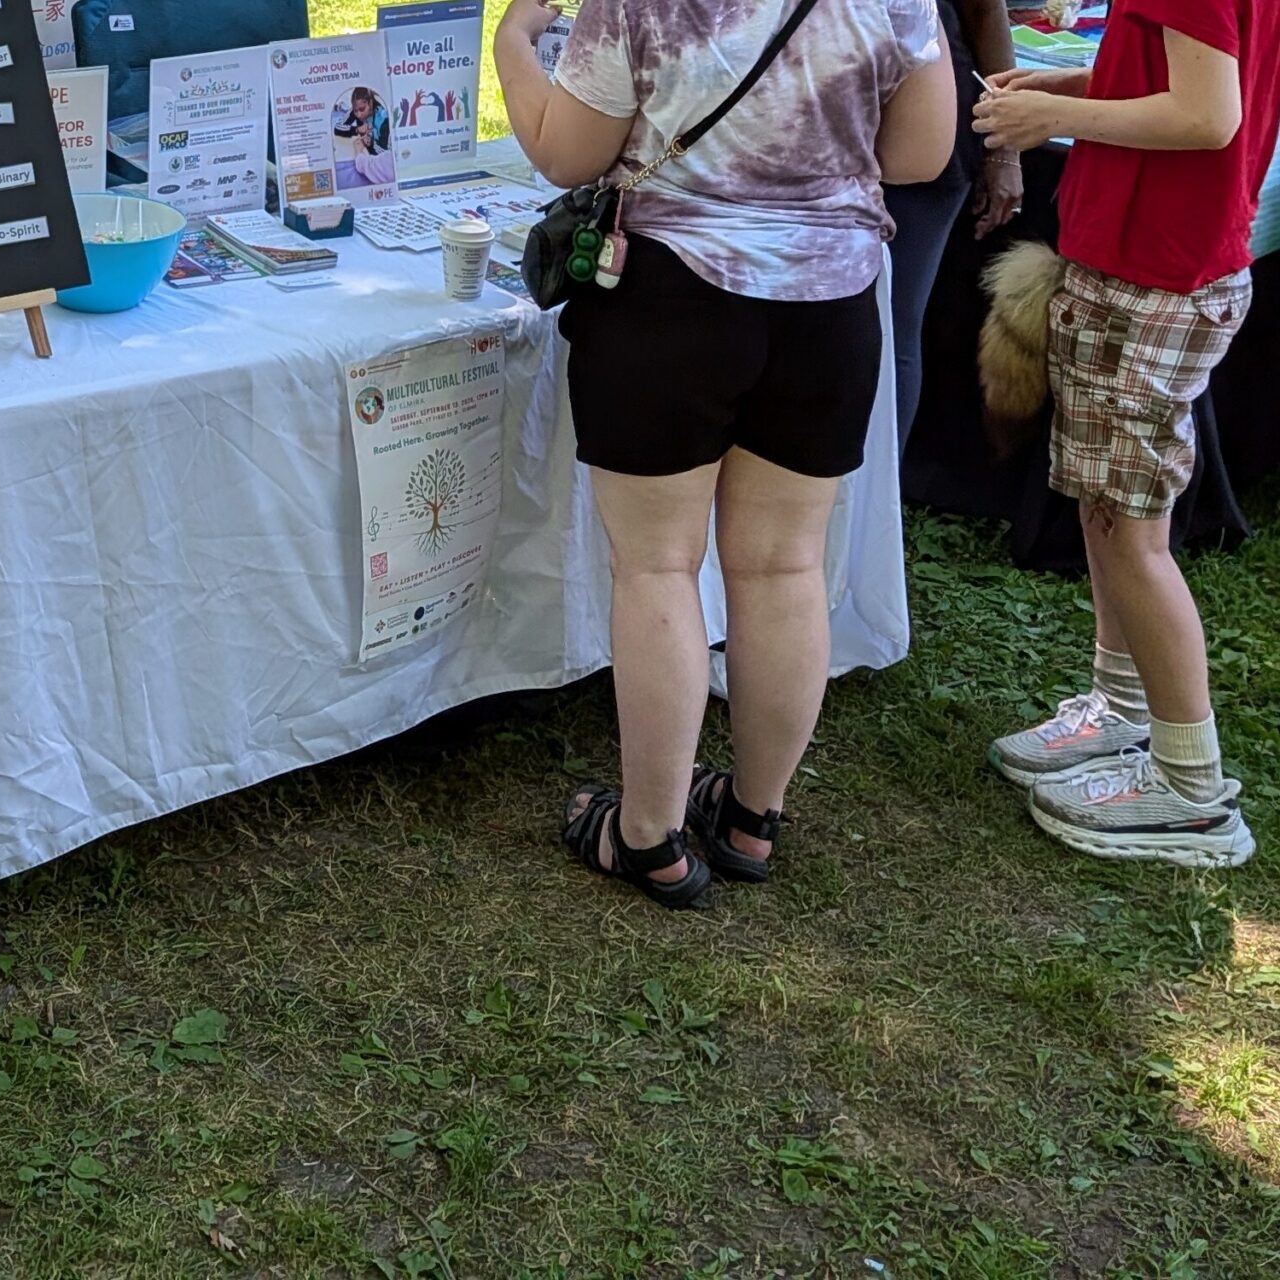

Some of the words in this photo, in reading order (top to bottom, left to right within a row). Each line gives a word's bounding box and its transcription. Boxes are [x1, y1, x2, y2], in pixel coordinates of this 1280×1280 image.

[407, 41, 430, 56] We
[434, 36, 453, 54] all
[308, 64, 328, 75] JOIN
[330, 62, 349, 72] OUR
[438, 54, 475, 71] here.
[300, 74, 340, 85] VOLUNTEER
[341, 71, 360, 80] TEAM
[58, 120, 84, 133] FOR
[160, 132, 187, 145] OCAF
[386, 374, 461, 402] MULTICULTURAL
[462, 361, 500, 384] FESTIVAL
[373, 438, 402, 455] Rooted
[425, 426, 458, 440] Growing
